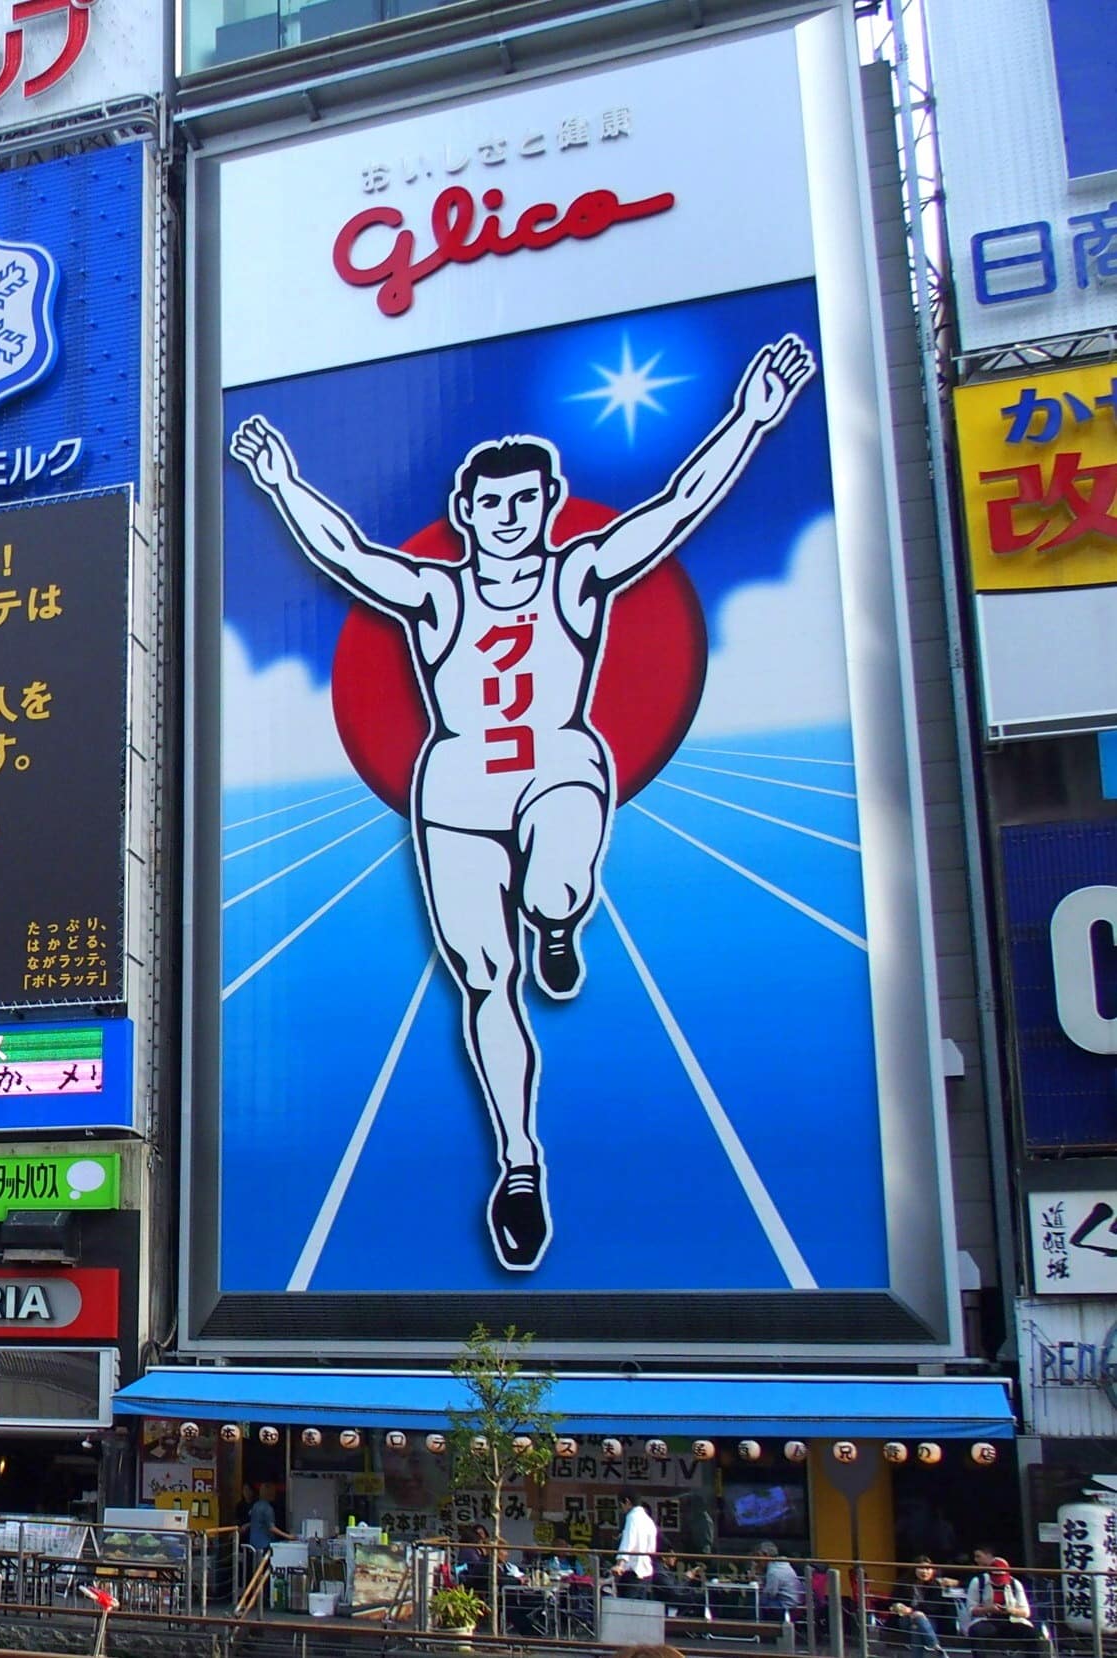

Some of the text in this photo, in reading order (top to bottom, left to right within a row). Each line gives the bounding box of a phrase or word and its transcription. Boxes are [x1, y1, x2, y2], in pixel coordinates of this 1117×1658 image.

[362, 105, 631, 194] おいしさと健康
[475, 613, 538, 774] グリコ
[27, 917, 108, 935] たっぷり、
[27, 935, 108, 953] はかどる、
[27, 952, 108, 971] ながラッテ。
[23, 970, 108, 990] 「ボトラッテ」
[1042, 1201, 1070, 1280] 道頓堀
